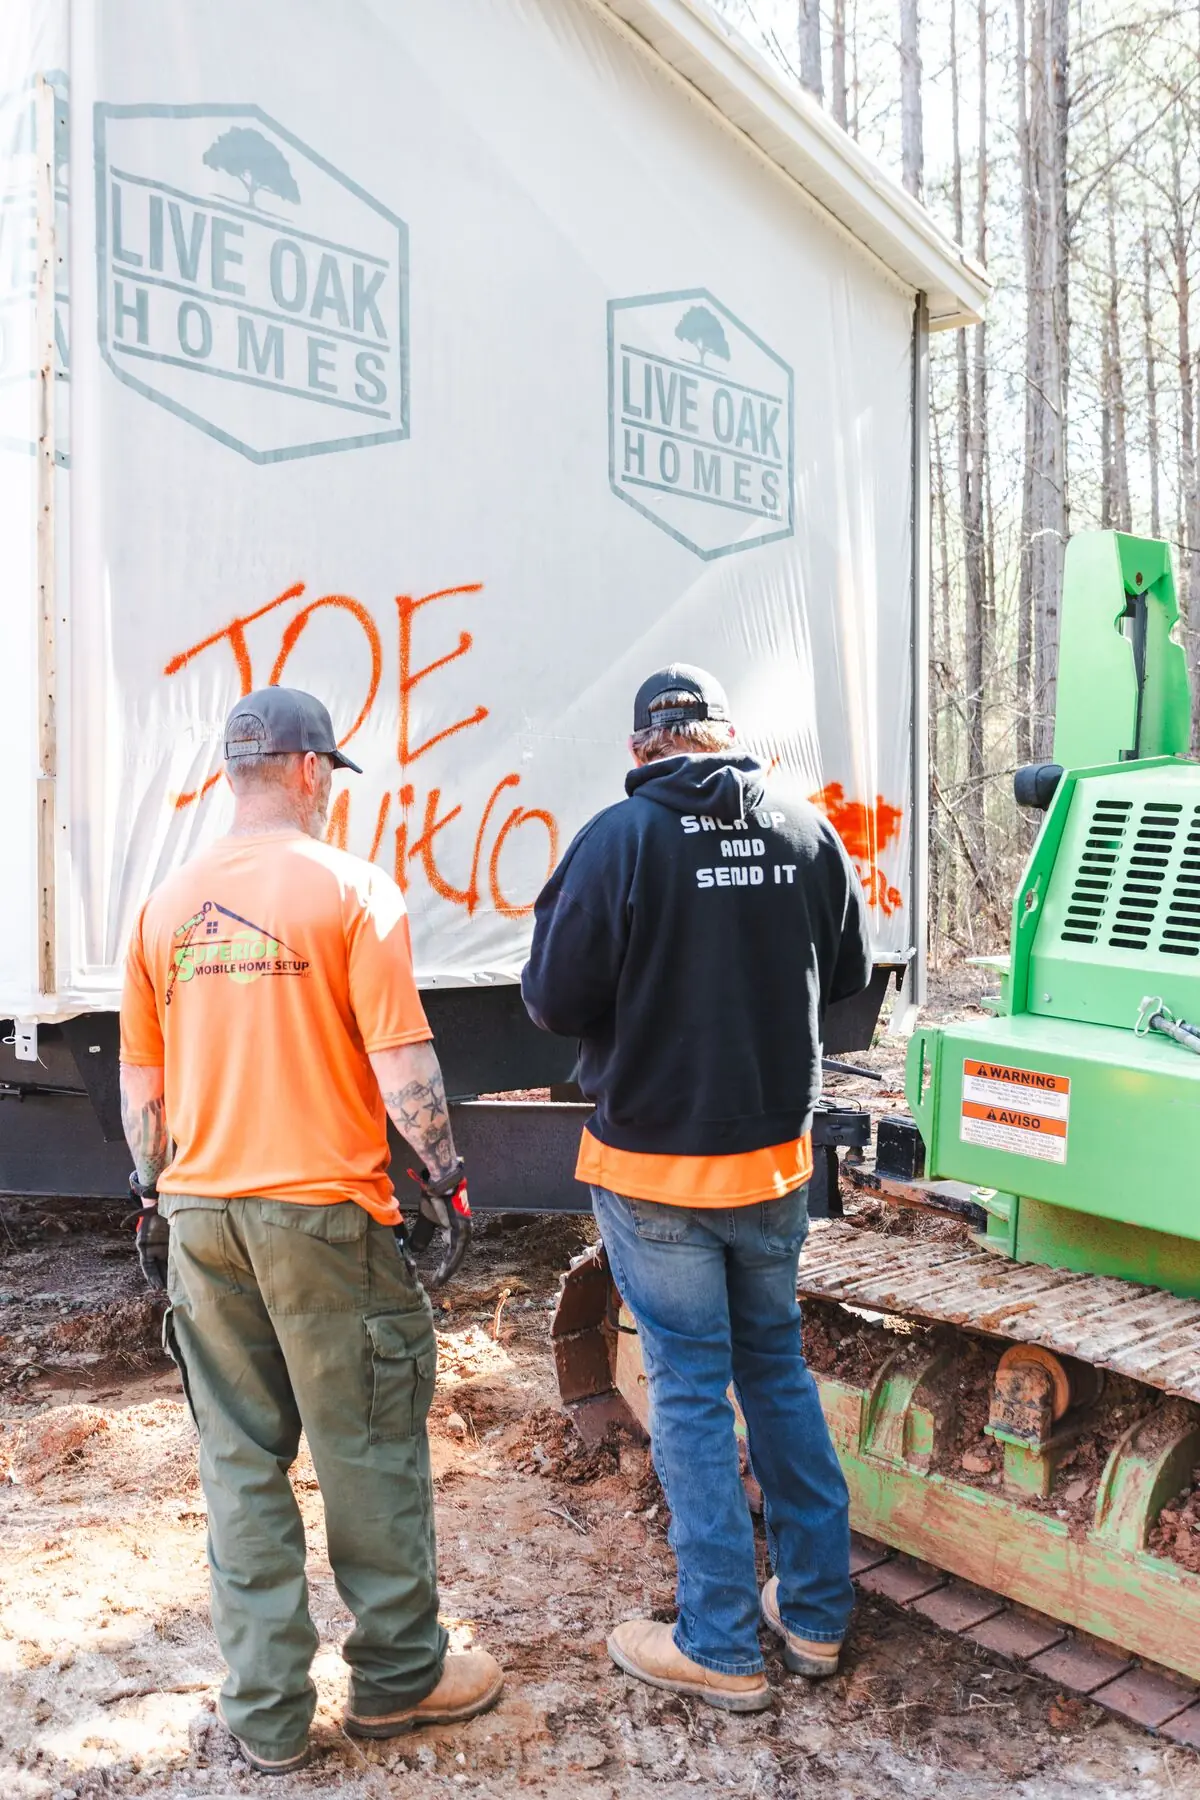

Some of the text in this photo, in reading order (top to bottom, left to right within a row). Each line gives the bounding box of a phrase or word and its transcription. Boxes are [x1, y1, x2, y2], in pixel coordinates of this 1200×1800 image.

[112, 182, 246, 297] LIVE
[270, 237, 388, 340] OAK
[113, 280, 388, 405] HOMES
[622, 355, 781, 460] LIVE OAK
[623, 429, 780, 511] HOMES
[756, 811, 786, 829] UP
[720, 838, 766, 857] AND
[696, 865, 797, 888] SEND IT
[174, 940, 280, 982] SUPERIOR
[195, 960, 310, 976] MOBILE HOME SETUP
[989, 1066, 1056, 1089] WARNING
[999, 1111, 1041, 1129] AVISO
